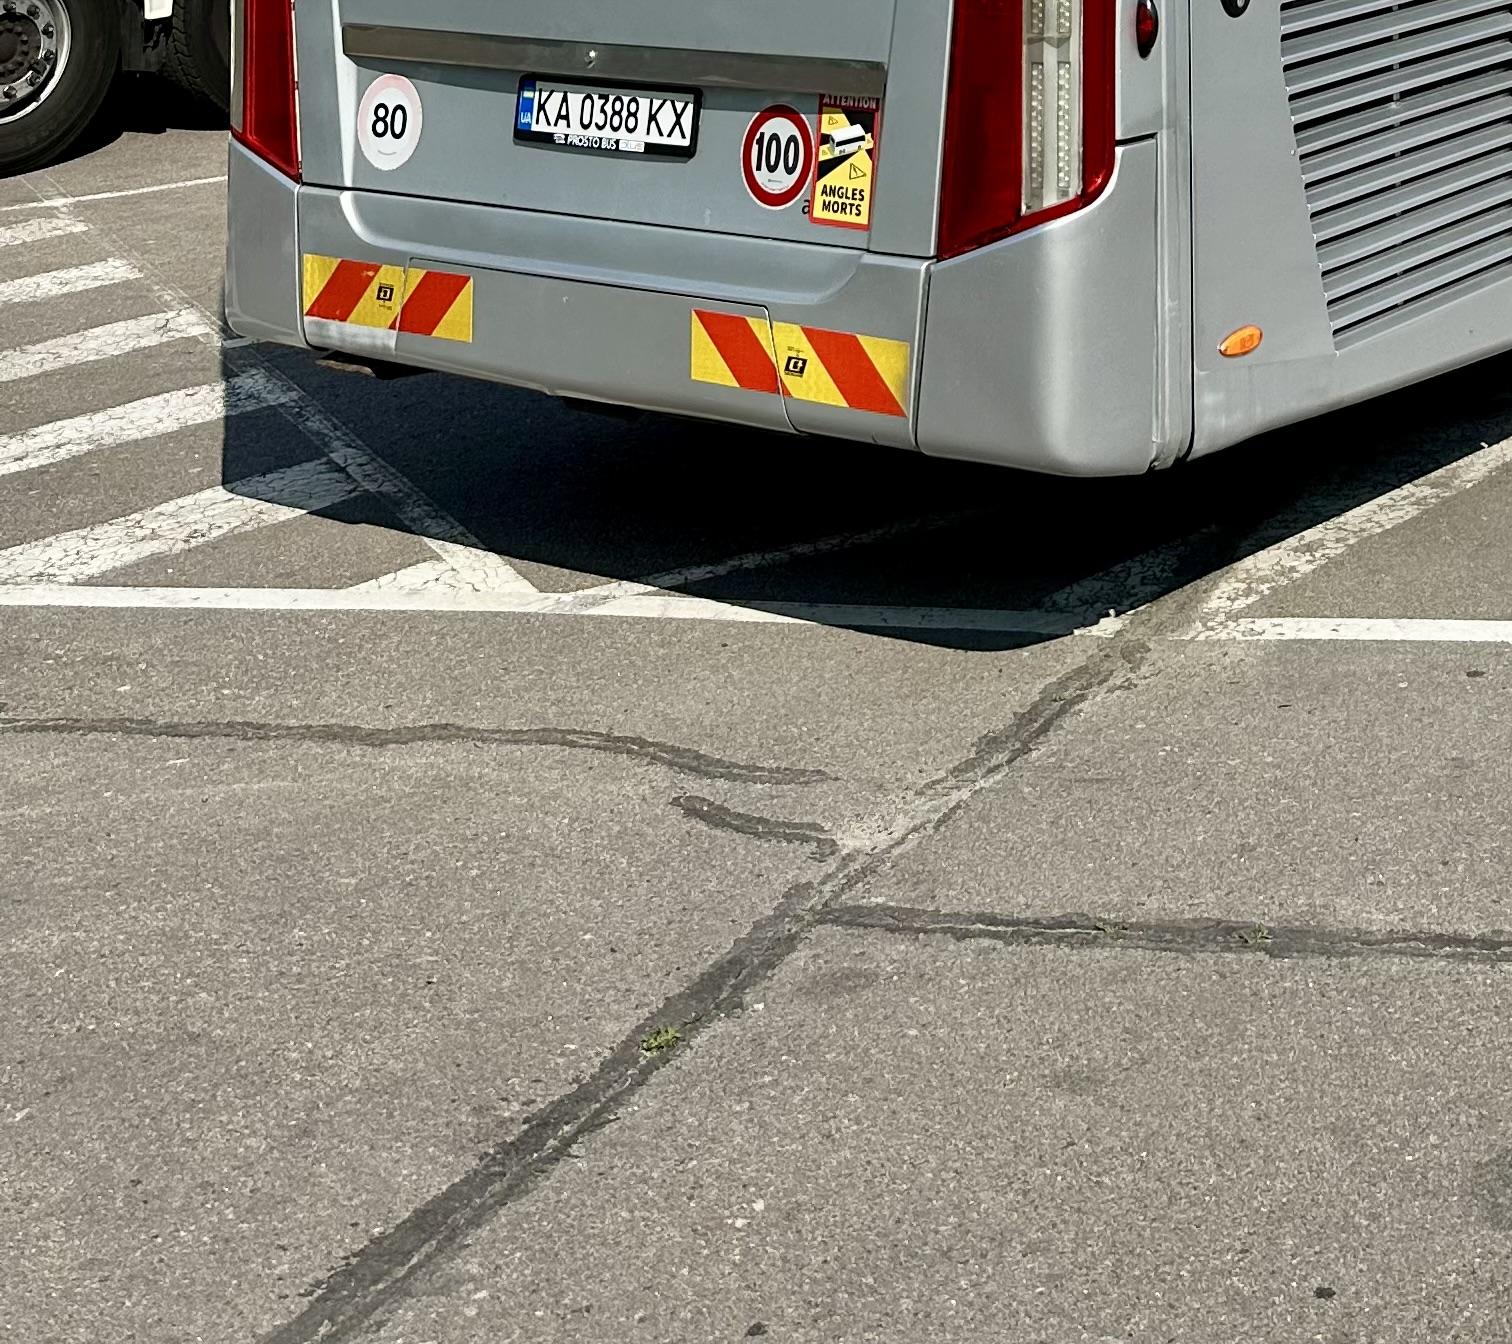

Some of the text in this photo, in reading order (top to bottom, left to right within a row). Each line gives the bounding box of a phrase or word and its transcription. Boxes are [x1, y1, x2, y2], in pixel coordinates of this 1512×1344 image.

[822, 94, 877, 109] ATTENTION
[371, 102, 408, 140] 80
[535, 88, 690, 139] KA 0388 KX
[567, 134, 600, 148] PROSTO
[601, 137, 617, 150] BUS
[755, 131, 800, 176] 100
[820, 183, 865, 202] ANGLES
[821, 199, 862, 217] MORTS
